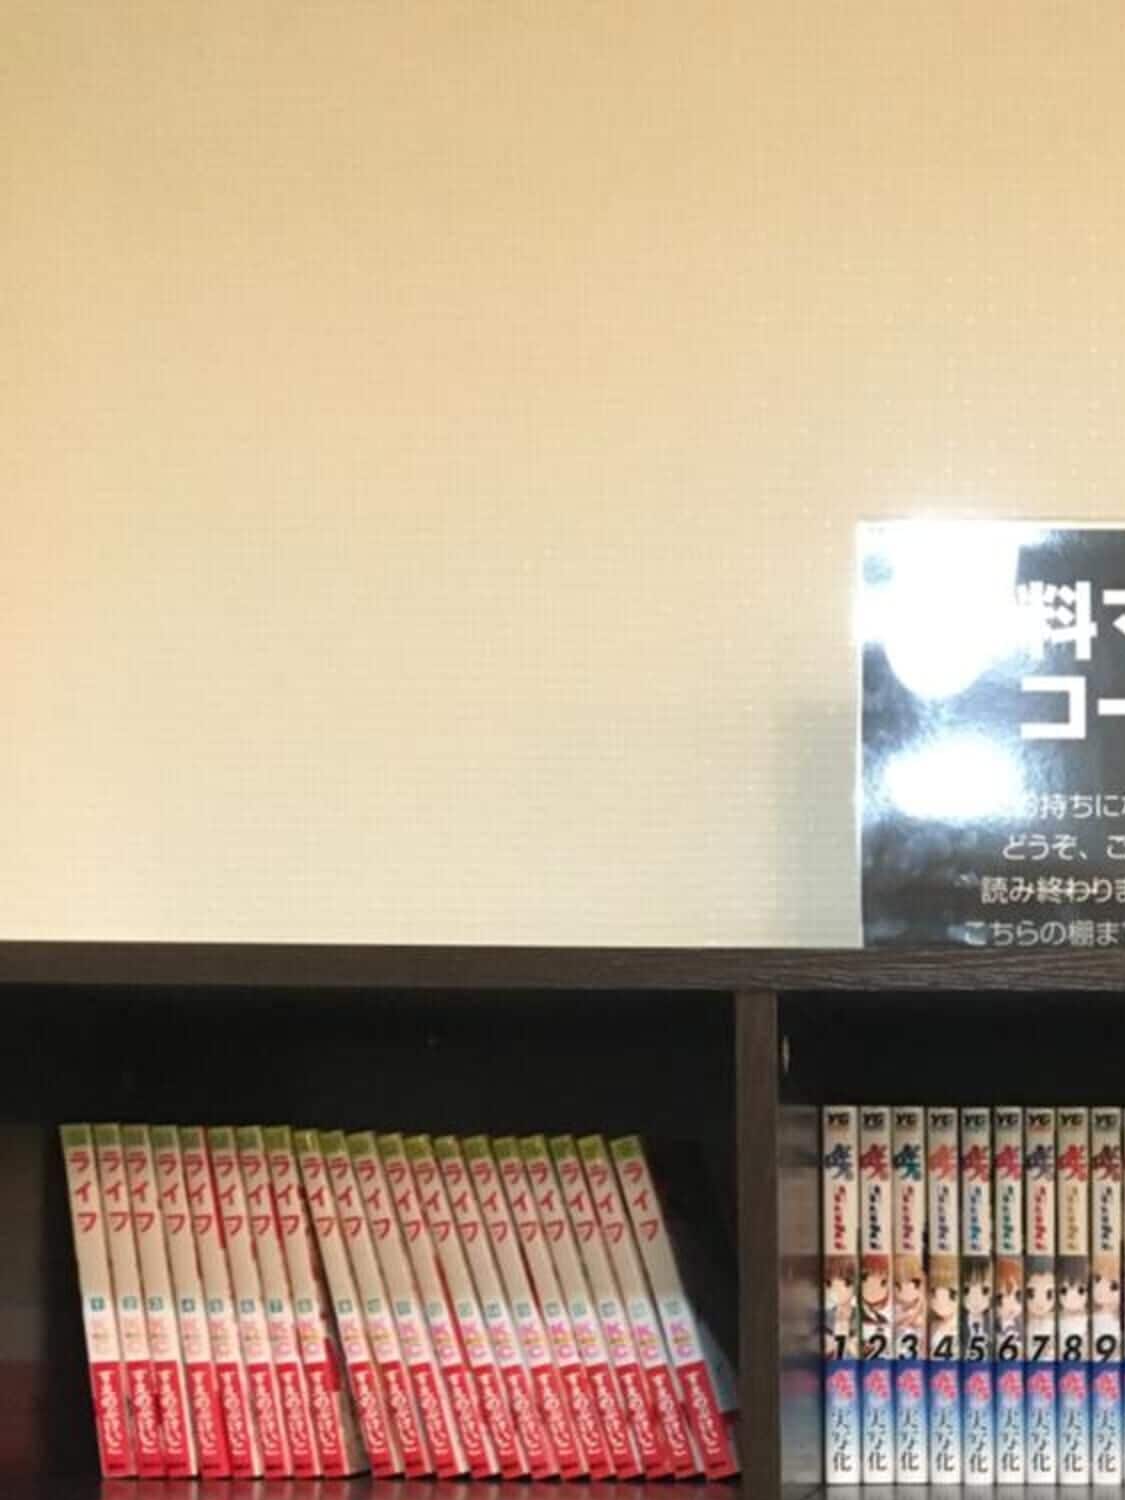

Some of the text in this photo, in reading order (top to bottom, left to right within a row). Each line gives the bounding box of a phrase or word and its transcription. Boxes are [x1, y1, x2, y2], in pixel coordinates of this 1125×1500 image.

[70, 1151, 96, 1232] ライフ
[103, 1151, 128, 1232] ライフ
[128, 1151, 155, 1232] ライフ
[160, 1153, 185, 1234] ライフ
[184, 1153, 212, 1234] ライフ
[215, 1154, 242, 1235] ライフ
[240, 1154, 270, 1234] ライフ
[272, 1154, 299, 1234] ライフ
[303, 1157, 334, 1237] ライフ
[329, 1157, 360, 1236] ライフ
[358, 1160, 390, 1238] ライフ
[386, 1161, 420, 1241] ライフ
[415, 1162, 449, 1241] ライフ
[446, 1162, 478, 1242] ライフ
[474, 1161, 506, 1241] ライフ
[503, 1163, 537, 1240] ライフ
[531, 1162, 564, 1241] ライフ
[562, 1162, 593, 1241] ライフ
[590, 1163, 623, 1243] ライフ
[624, 1161, 658, 1240] ライフ
[834, 1335, 847, 1360] 1
[865, 1334, 887, 1360] 2
[900, 1334, 918, 1360] 3
[934, 1335, 953, 1359] 4
[967, 1337, 985, 1361] 5
[1000, 1335, 1018, 1361] 6
[1032, 1335, 1050, 1361] 7
[1064, 1334, 1082, 1361] 8
[1096, 1334, 1117, 1362] 9
